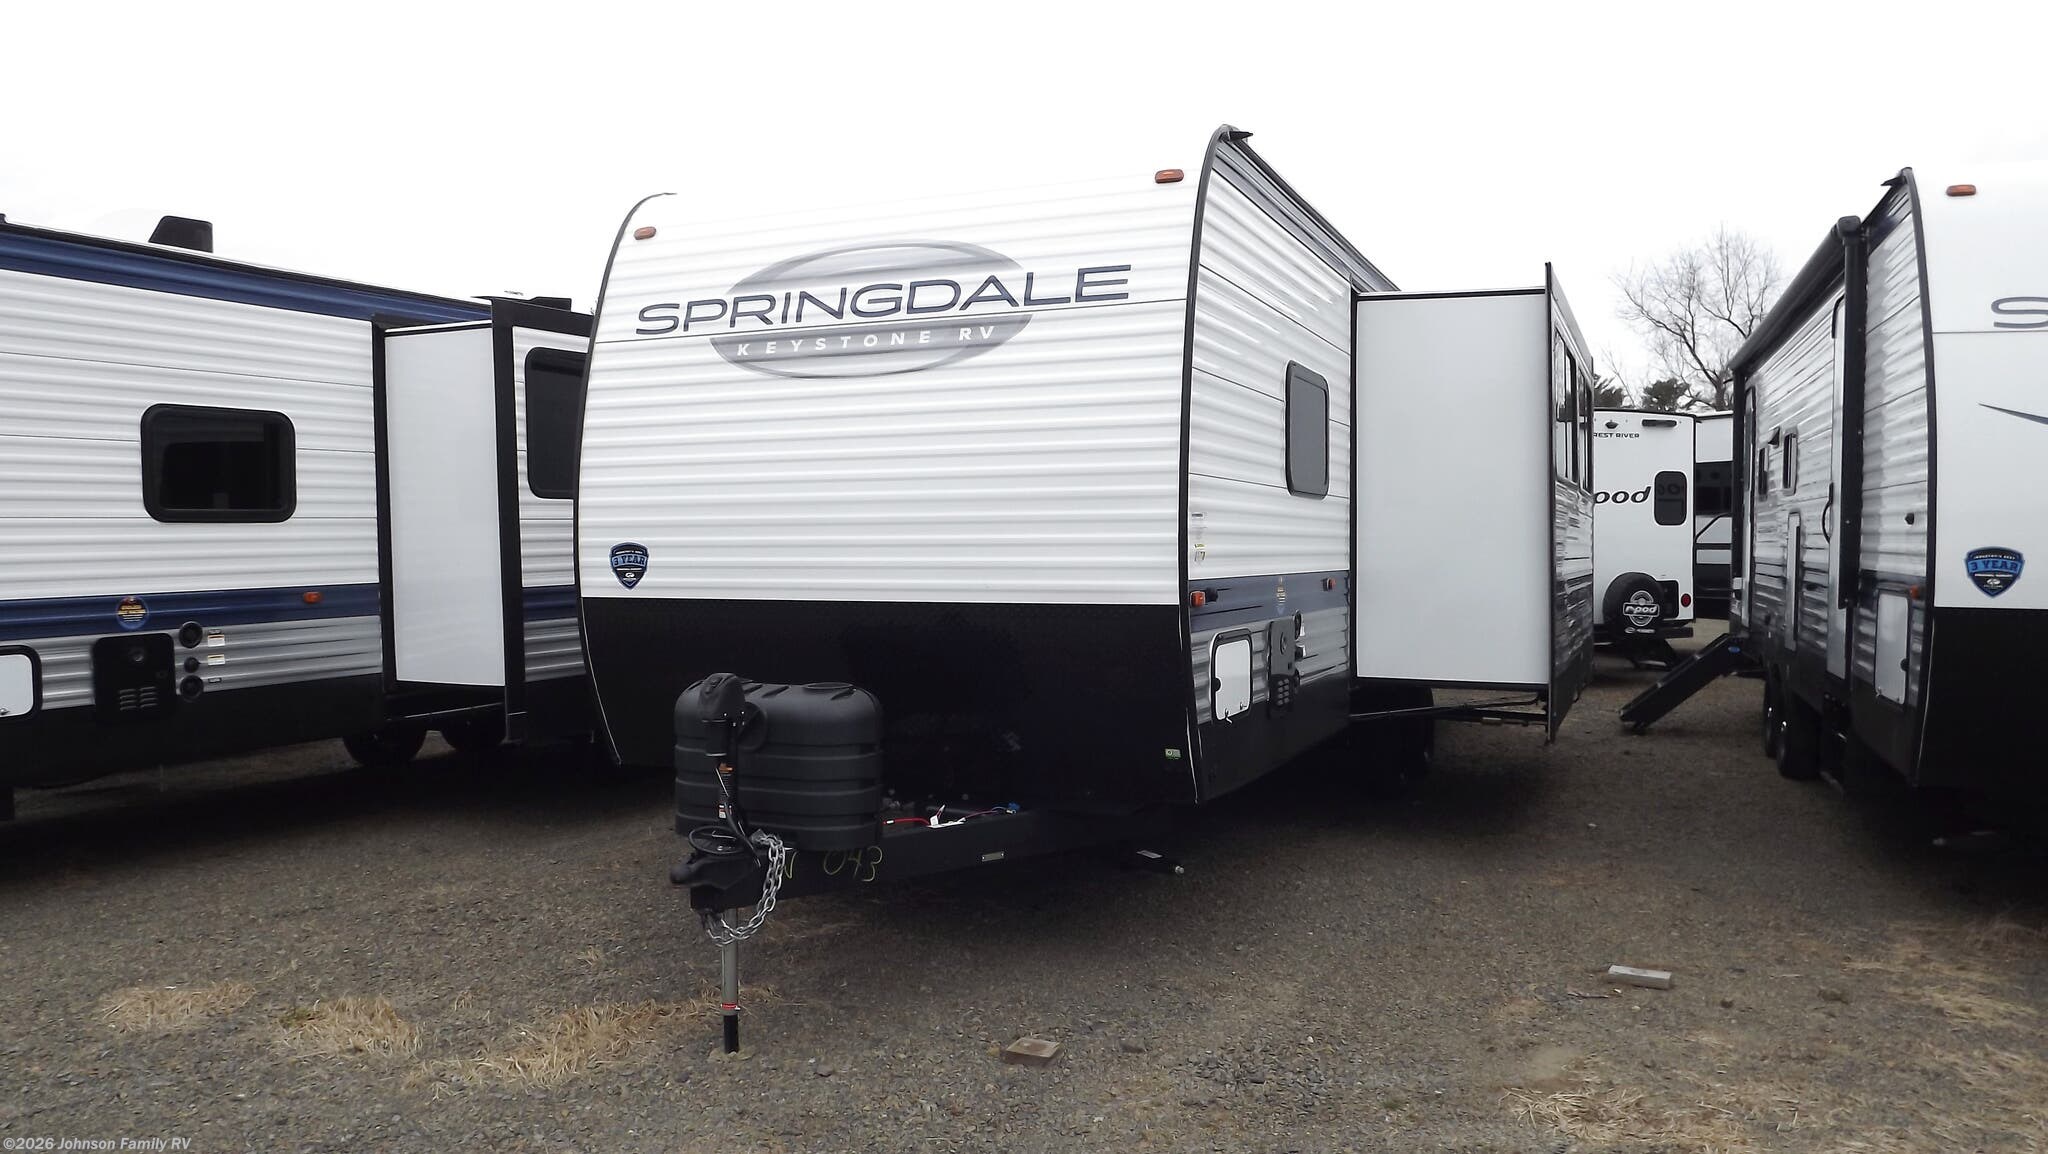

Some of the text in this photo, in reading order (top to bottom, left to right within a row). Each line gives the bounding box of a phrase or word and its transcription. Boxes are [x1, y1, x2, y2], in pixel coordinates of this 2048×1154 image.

[636, 264, 1132, 335] SPRINGDALE
[736, 326, 995, 356] KEYSTONE RV
[613, 555, 645, 566] 3 YEAR
[1970, 560, 2018, 572] 3 YEAR
